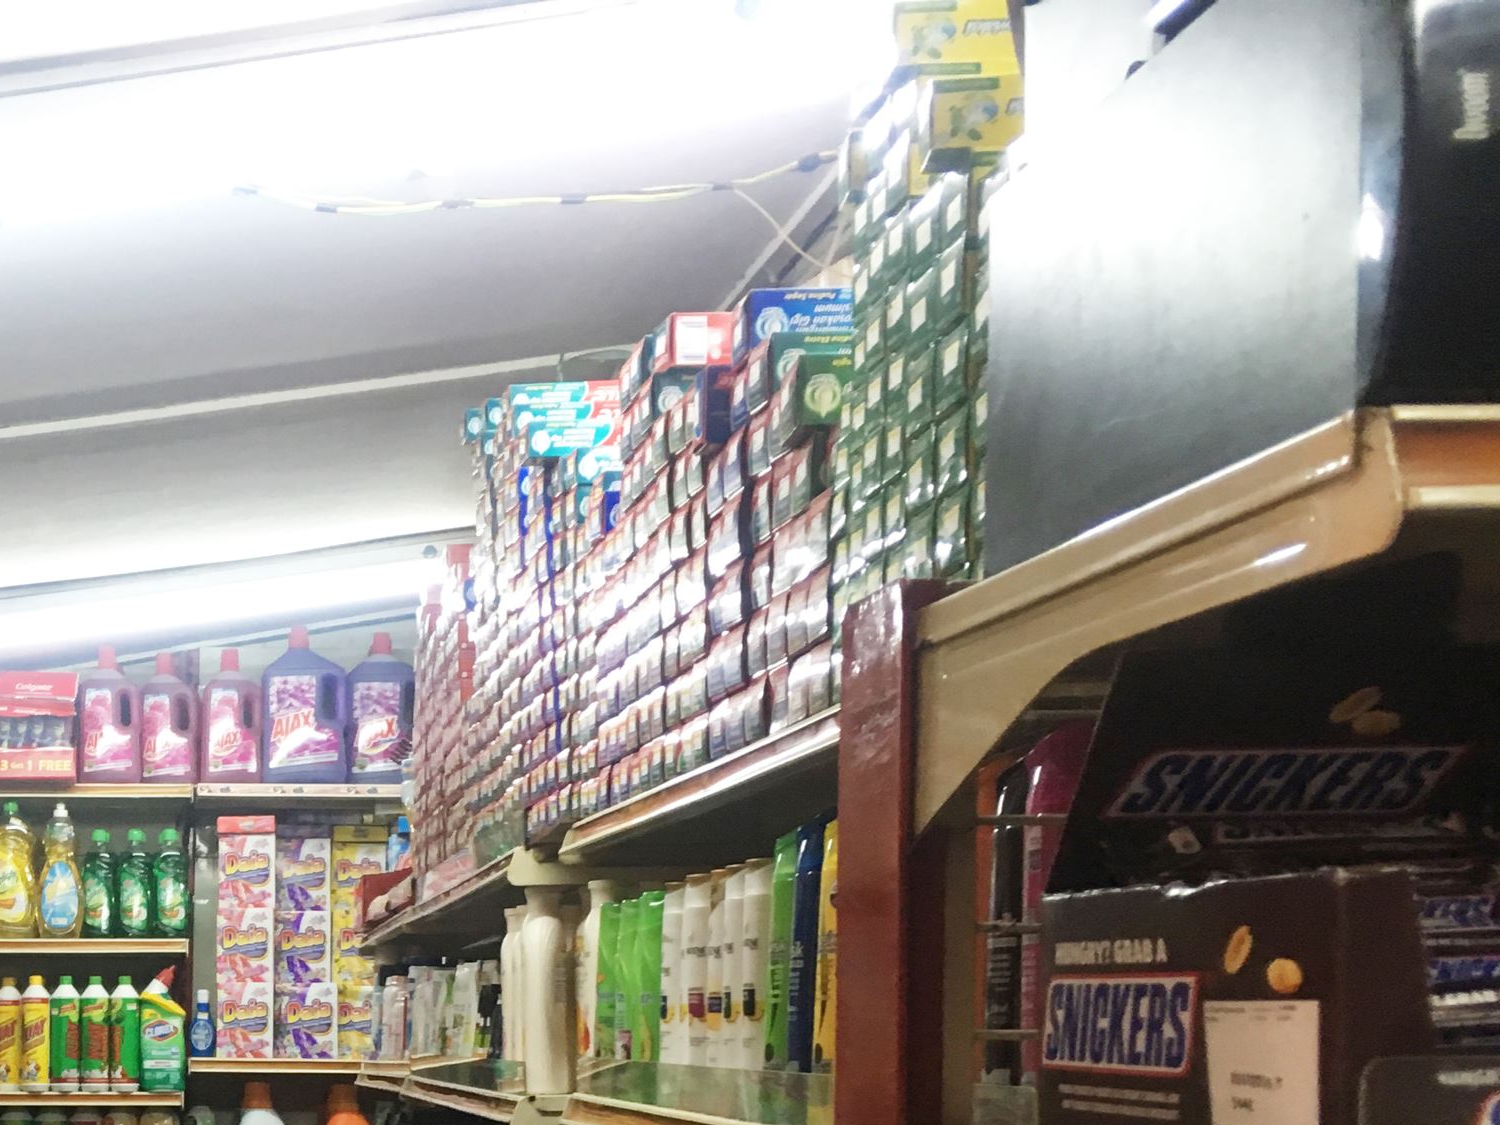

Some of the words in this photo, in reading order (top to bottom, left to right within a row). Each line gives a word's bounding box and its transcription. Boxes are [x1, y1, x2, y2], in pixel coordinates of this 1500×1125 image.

[0, 760, 8, 771] 3
[38, 760, 72, 771] FREE
[1120, 751, 1452, 813] SNICKERS
[224, 850, 271, 875] Daia
[221, 924, 270, 951] Daia
[280, 926, 327, 951] Daia
[221, 998, 270, 1025] Daia
[285, 998, 333, 1025] Daia
[1044, 981, 1192, 1069] SNICKERS
